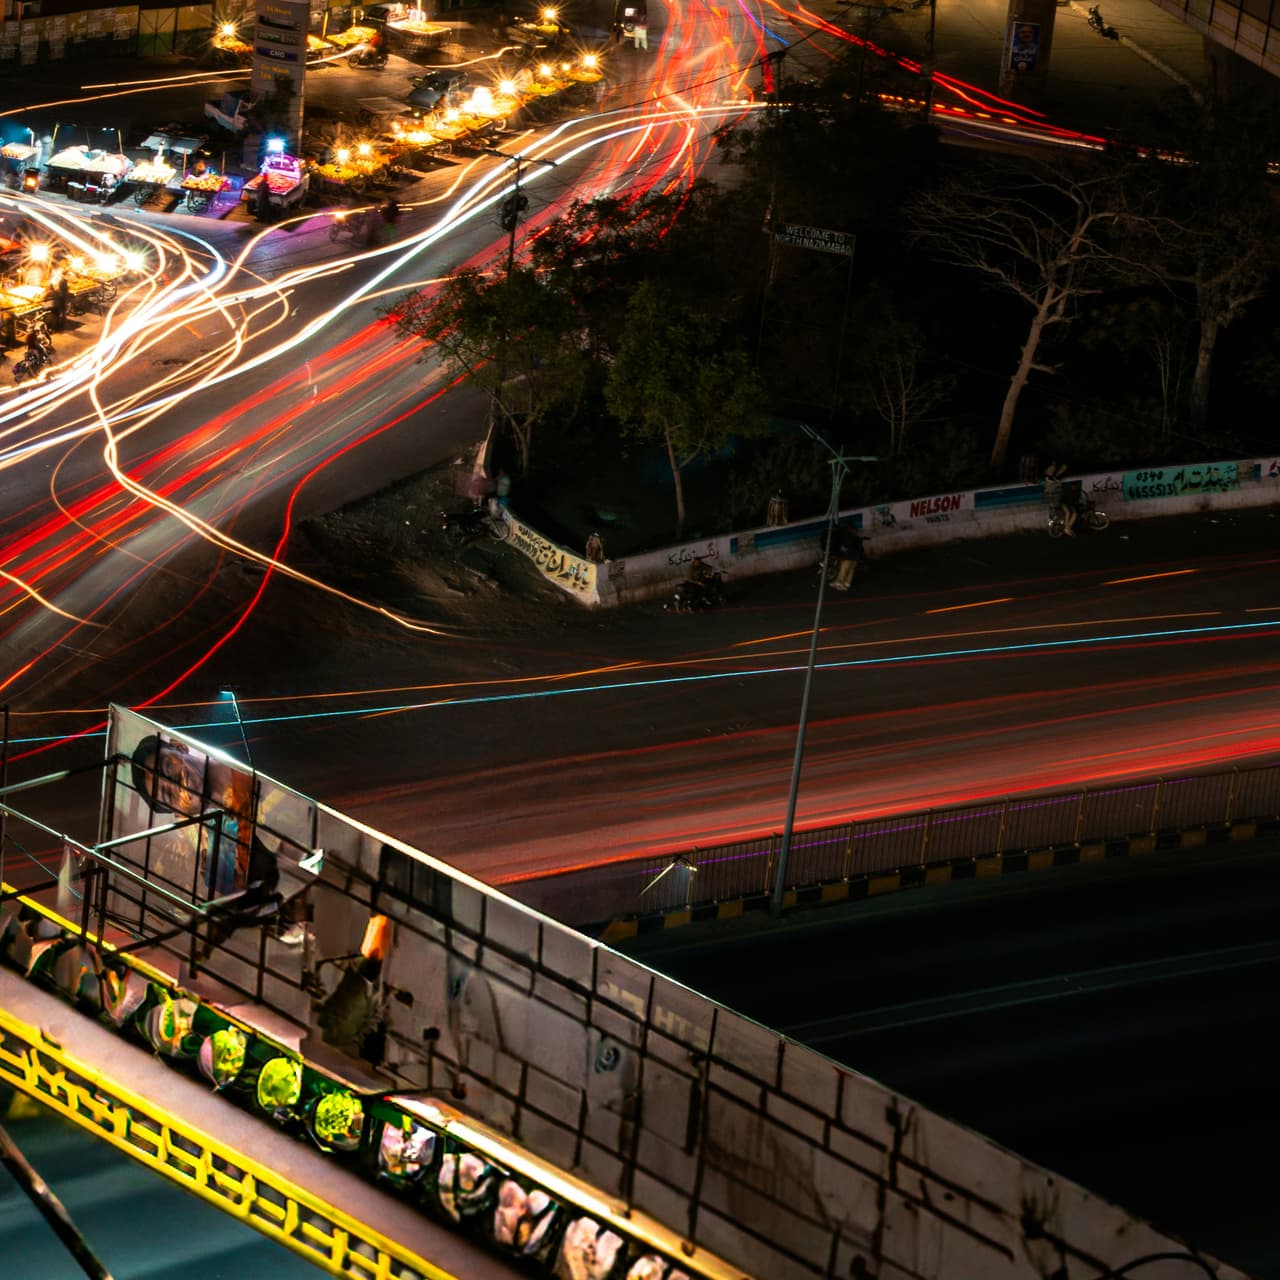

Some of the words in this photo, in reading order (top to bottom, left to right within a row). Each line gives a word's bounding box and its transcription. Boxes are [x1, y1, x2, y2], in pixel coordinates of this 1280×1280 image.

[774, 232, 802, 249] NORTH
[785, 224, 831, 241] WELCOME
[833, 232, 845, 244] TO
[910, 494, 962, 518] NELSON
